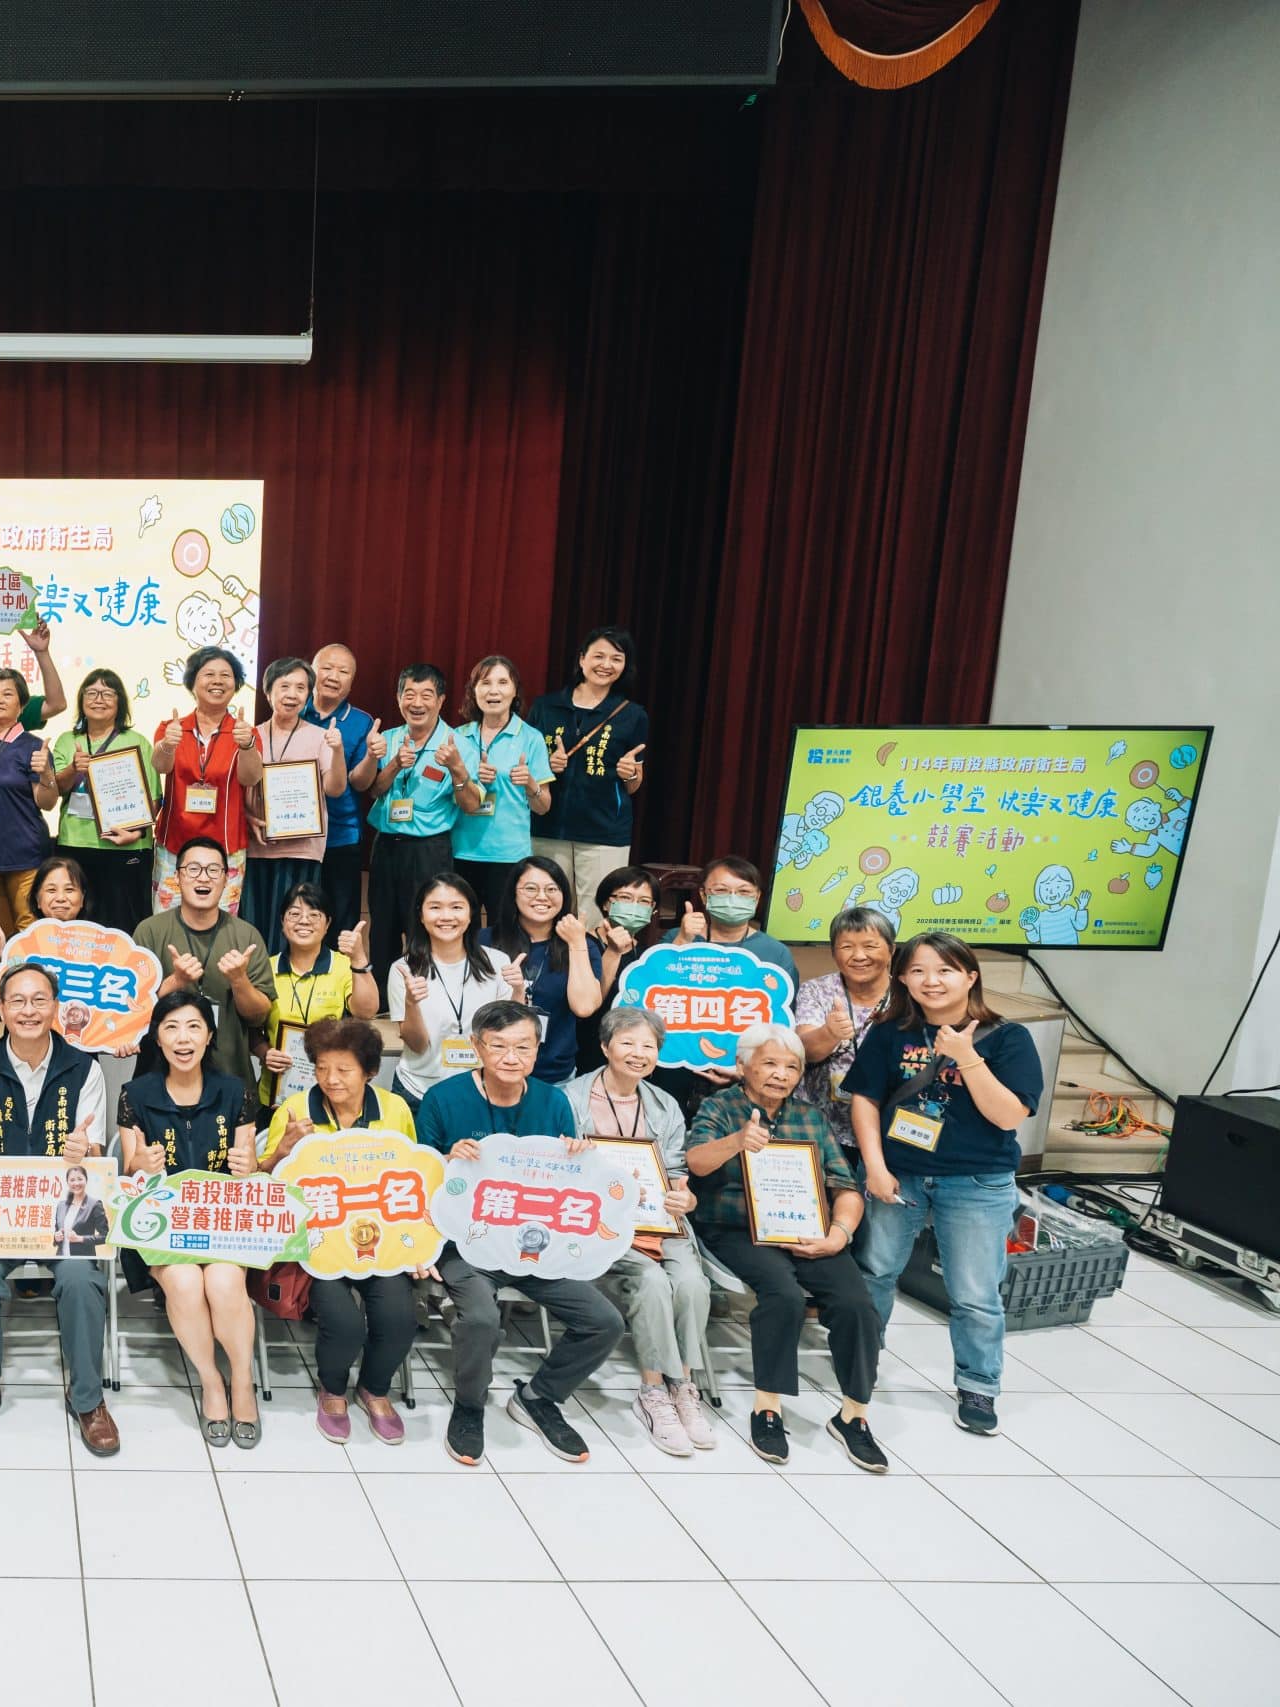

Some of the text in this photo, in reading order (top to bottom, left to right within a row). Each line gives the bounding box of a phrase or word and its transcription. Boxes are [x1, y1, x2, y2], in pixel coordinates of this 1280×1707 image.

[898, 756, 1087, 774] 114年南投縣政府衛生局
[849, 779, 986, 817] 銀養小學堂
[926, 823, 1025, 858] 競賽活動
[652, 994, 763, 1026] 第四名
[4, 1096, 14, 1121] 局長
[45, 1120, 56, 1156] 衛生局
[164, 1128, 177, 1166] 副局長
[181, 1180, 287, 1208] 南投縣社區
[302, 1177, 422, 1221] 第一名
[480, 1185, 597, 1229] 第二名
[171, 1206, 296, 1234] 營養推廣中心
